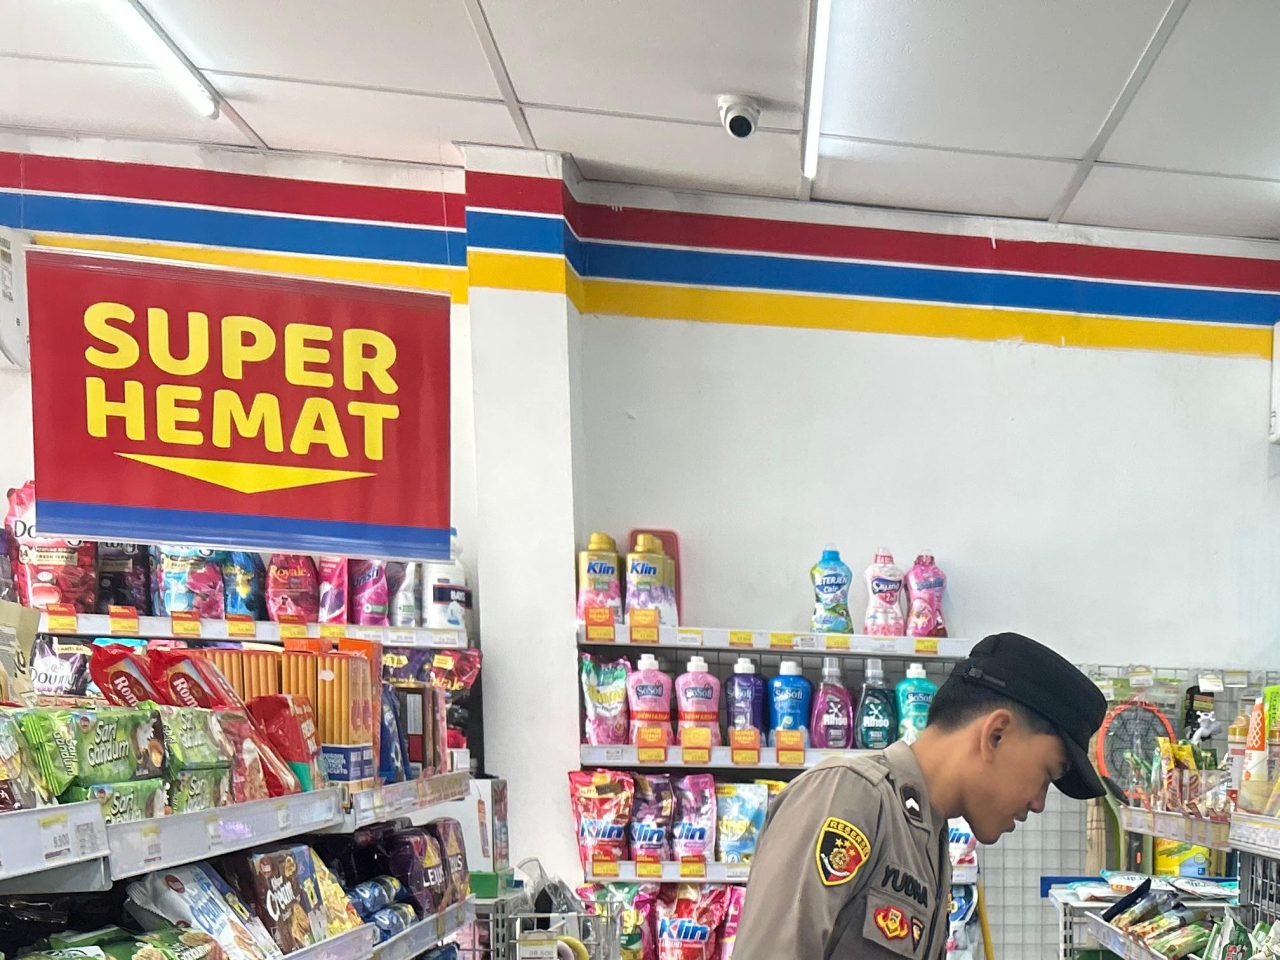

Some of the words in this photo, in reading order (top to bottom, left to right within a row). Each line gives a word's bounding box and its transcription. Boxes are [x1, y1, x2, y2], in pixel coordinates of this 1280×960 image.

[83, 302, 399, 394] SUPER
[85, 377, 400, 461] HEMAT
[587, 560, 616, 576] Klin
[630, 561, 657, 576] Klin
[113, 674, 140, 707] Rom
[172, 676, 199, 708] Rom
[636, 684, 663, 698] SoSoft
[685, 685, 713, 699] SoSoft
[774, 686, 803, 700] SoSoft
[823, 715, 848, 726] Rinso
[863, 716, 889, 728] Rinso
[95, 718, 119, 744] Sari
[88, 738, 130, 767] Gandum
[581, 818, 626, 840] Klin
[948, 827, 970, 845] lin
[658, 917, 711, 941] Klin
